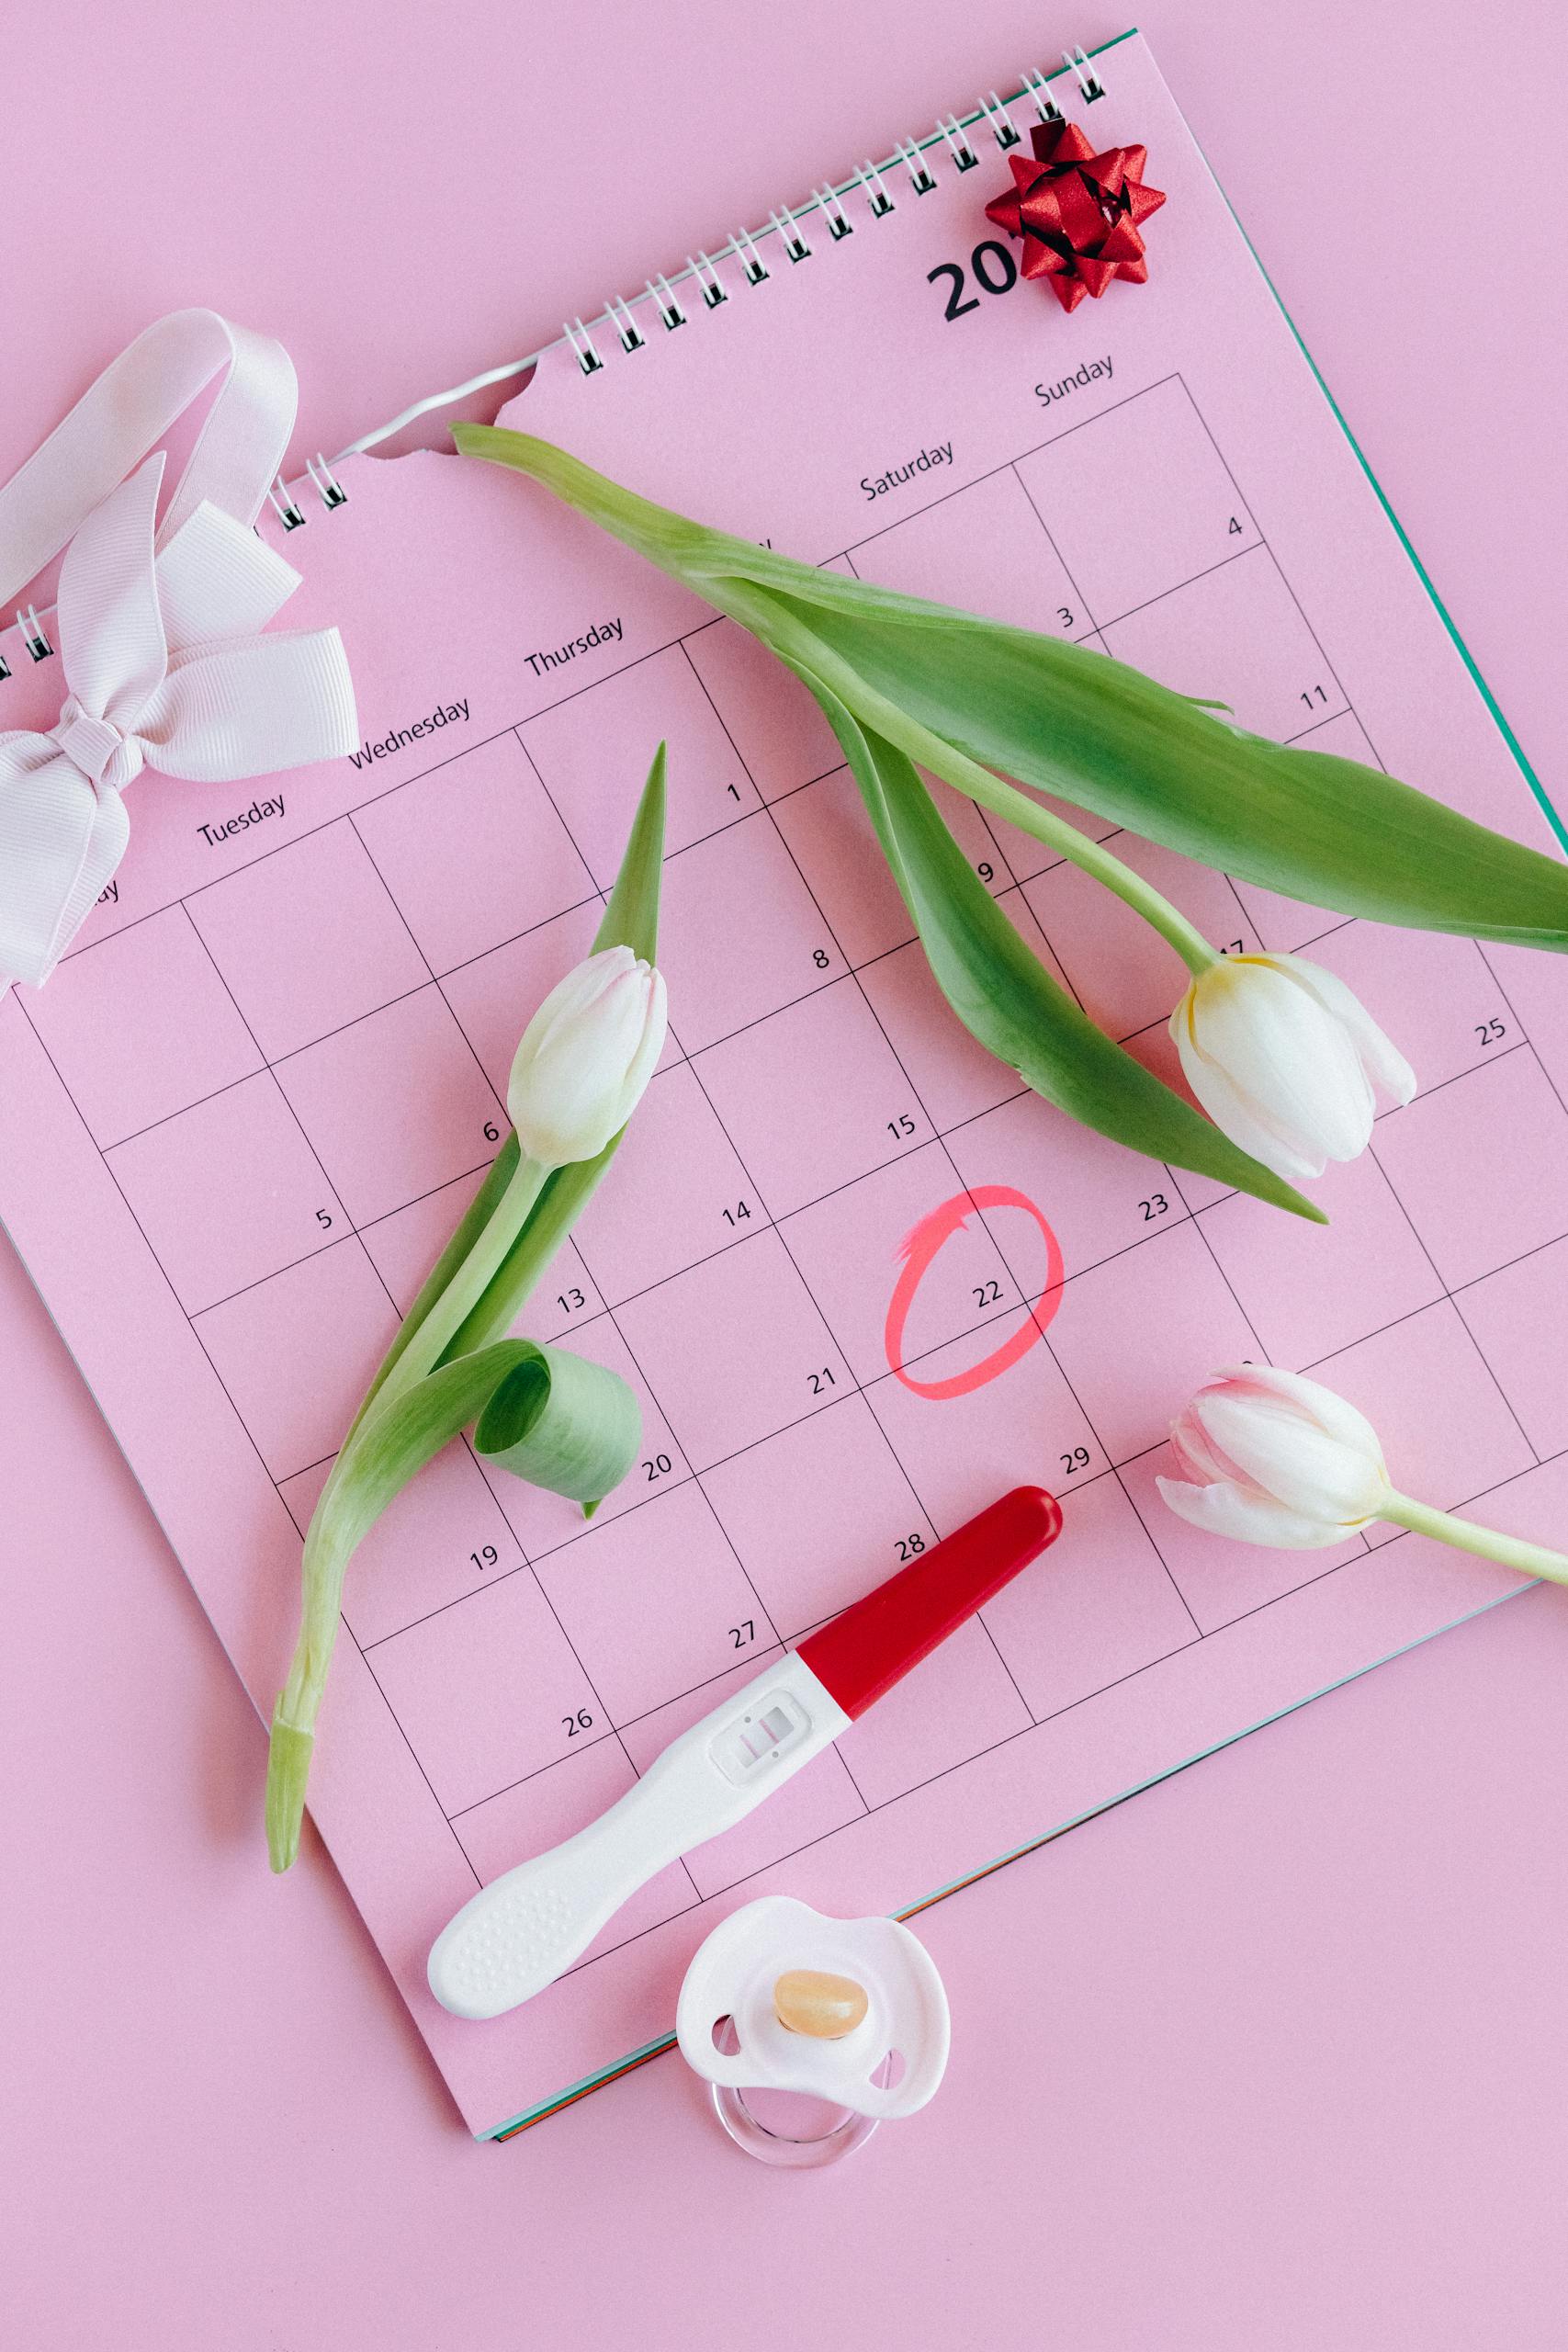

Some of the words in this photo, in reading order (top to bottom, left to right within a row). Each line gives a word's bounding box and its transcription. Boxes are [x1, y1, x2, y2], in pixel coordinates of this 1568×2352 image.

[926, 240, 1018, 323] 20
[1034, 355, 1113, 408] Sunday
[860, 441, 953, 502] Saturday
[1228, 515, 1243, 535] 4
[1056, 607, 1074, 628] 3
[523, 616, 623, 677] Thursday
[1300, 684, 1328, 710] 11
[347, 697, 470, 770] Wednesday
[727, 783, 741, 802] 1
[196, 794, 286, 847] Tuesday
[977, 862, 994, 883] 9
[812, 949, 830, 969] 8
[1219, 938, 1244, 955] 7
[1474, 1017, 1506, 1046] 25
[483, 1121, 500, 1142] 6
[886, 1114, 916, 1140] 15
[315, 1208, 333, 1230] 5
[722, 1200, 751, 1227] 14
[1137, 1193, 1169, 1222] 23
[557, 1288, 585, 1314] 13
[972, 1280, 1004, 1308] 22
[807, 1367, 836, 1396] 21
[641, 1453, 672, 1482] 20
[1059, 1446, 1090, 1476] 29
[469, 1545, 498, 1571] 19
[894, 1532, 926, 1562] 28
[728, 1619, 755, 1649] 27
[561, 1707, 593, 1738] 26
